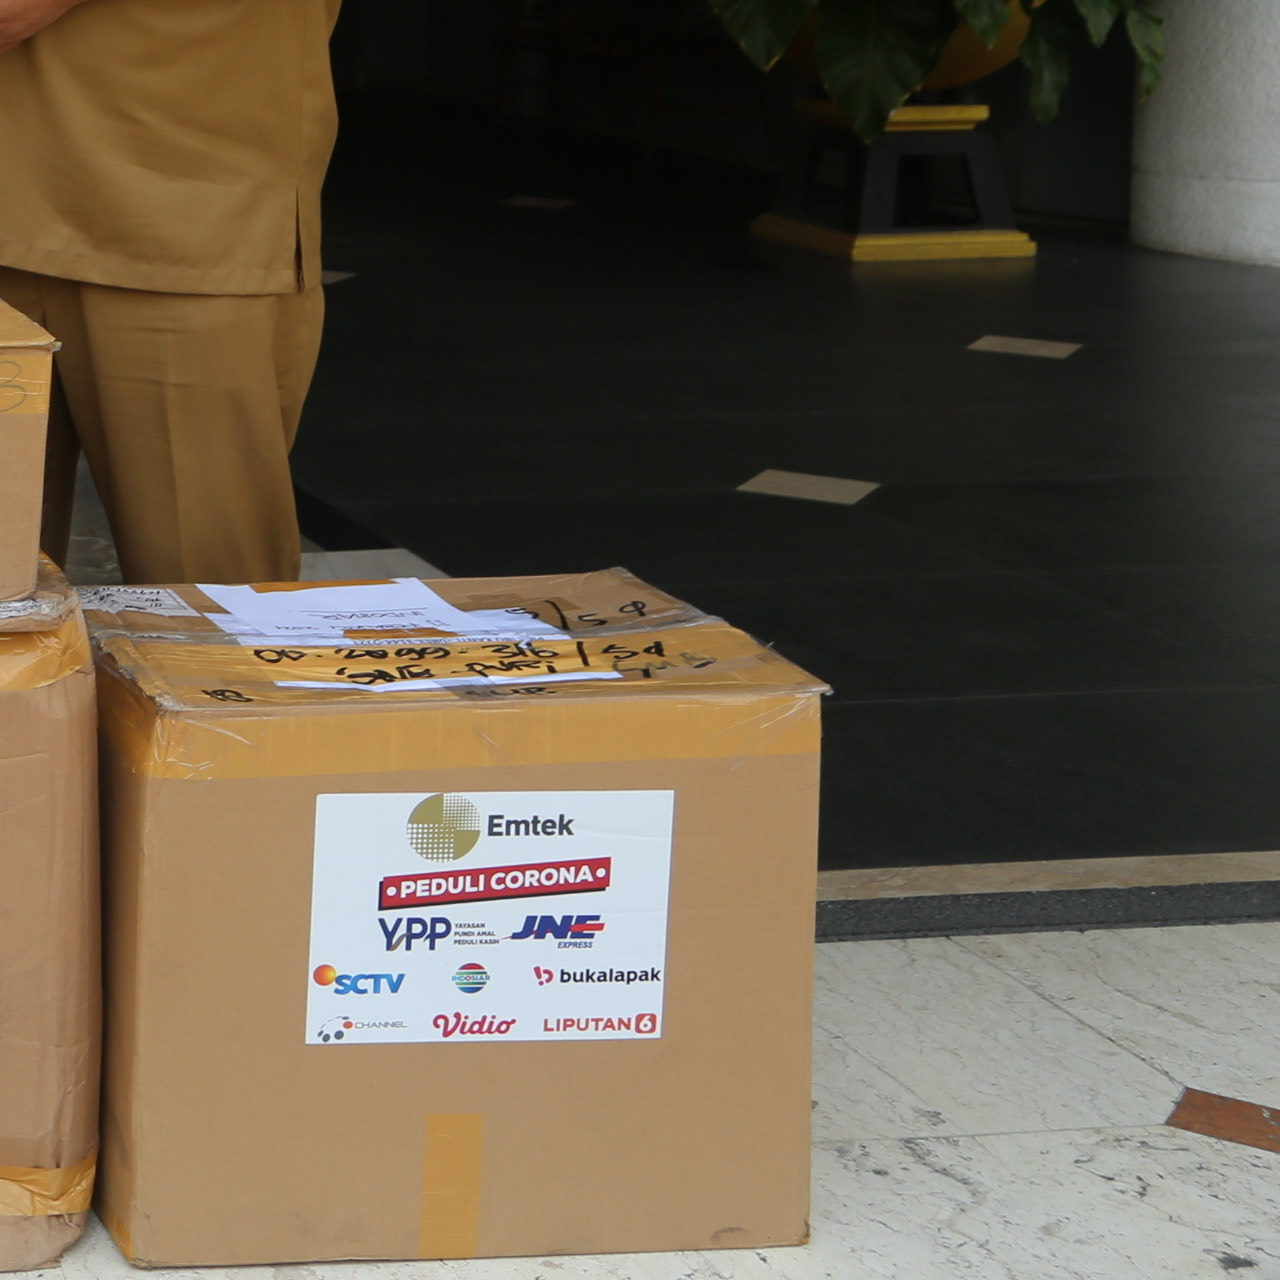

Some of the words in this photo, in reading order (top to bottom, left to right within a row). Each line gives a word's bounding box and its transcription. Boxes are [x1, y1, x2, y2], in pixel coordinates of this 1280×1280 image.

[487, 814, 574, 837] Emtek
[400, 877, 484, 899] PEDULI
[490, 865, 594, 890] CORONA
[378, 917, 451, 951] YPP
[510, 915, 606, 939] JNE
[333, 973, 406, 995] SCTV
[560, 967, 661, 986] bukalapak
[433, 1012, 516, 1038] Vidio
[543, 1017, 631, 1032] LIPUTAN
